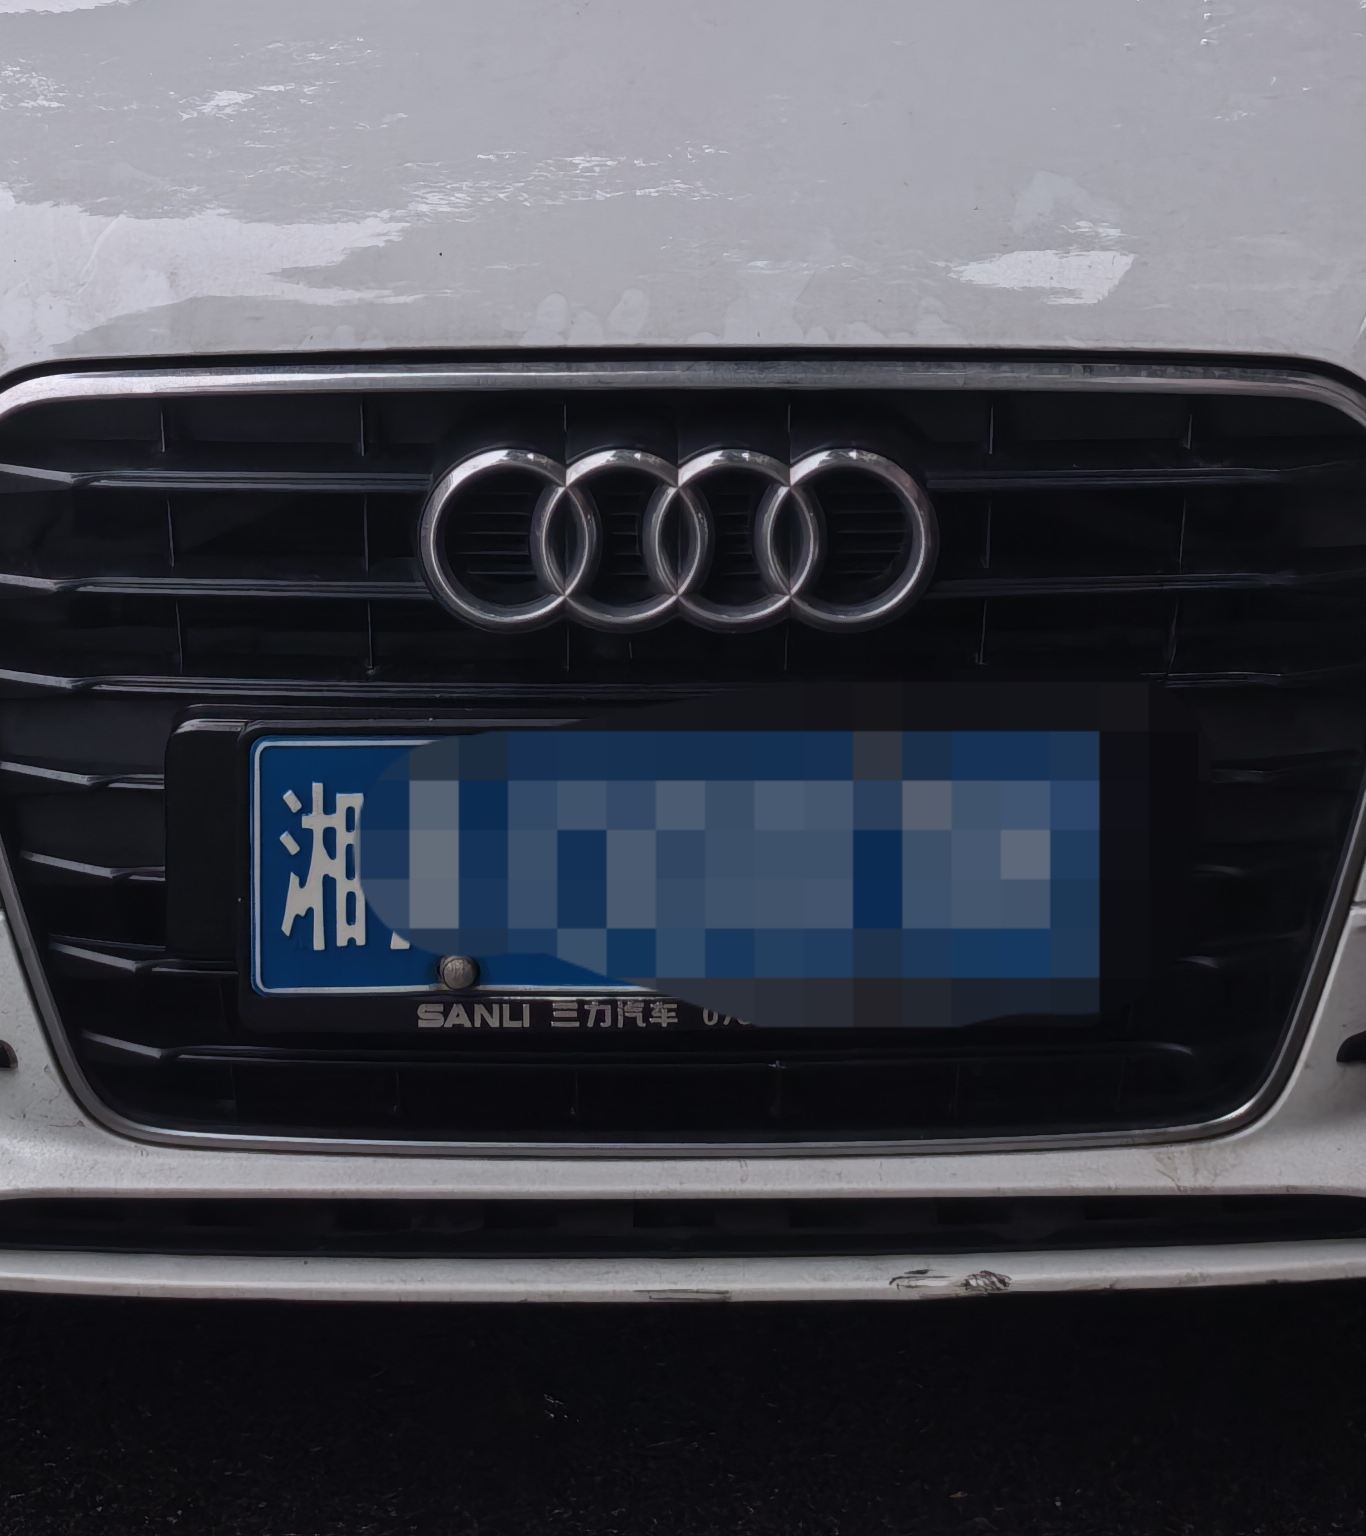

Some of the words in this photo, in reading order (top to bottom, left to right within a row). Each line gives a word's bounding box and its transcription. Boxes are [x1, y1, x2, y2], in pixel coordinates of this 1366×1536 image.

[417, 1002, 530, 1028] SANLI
[550, 1001, 679, 1028] 三力汽车
